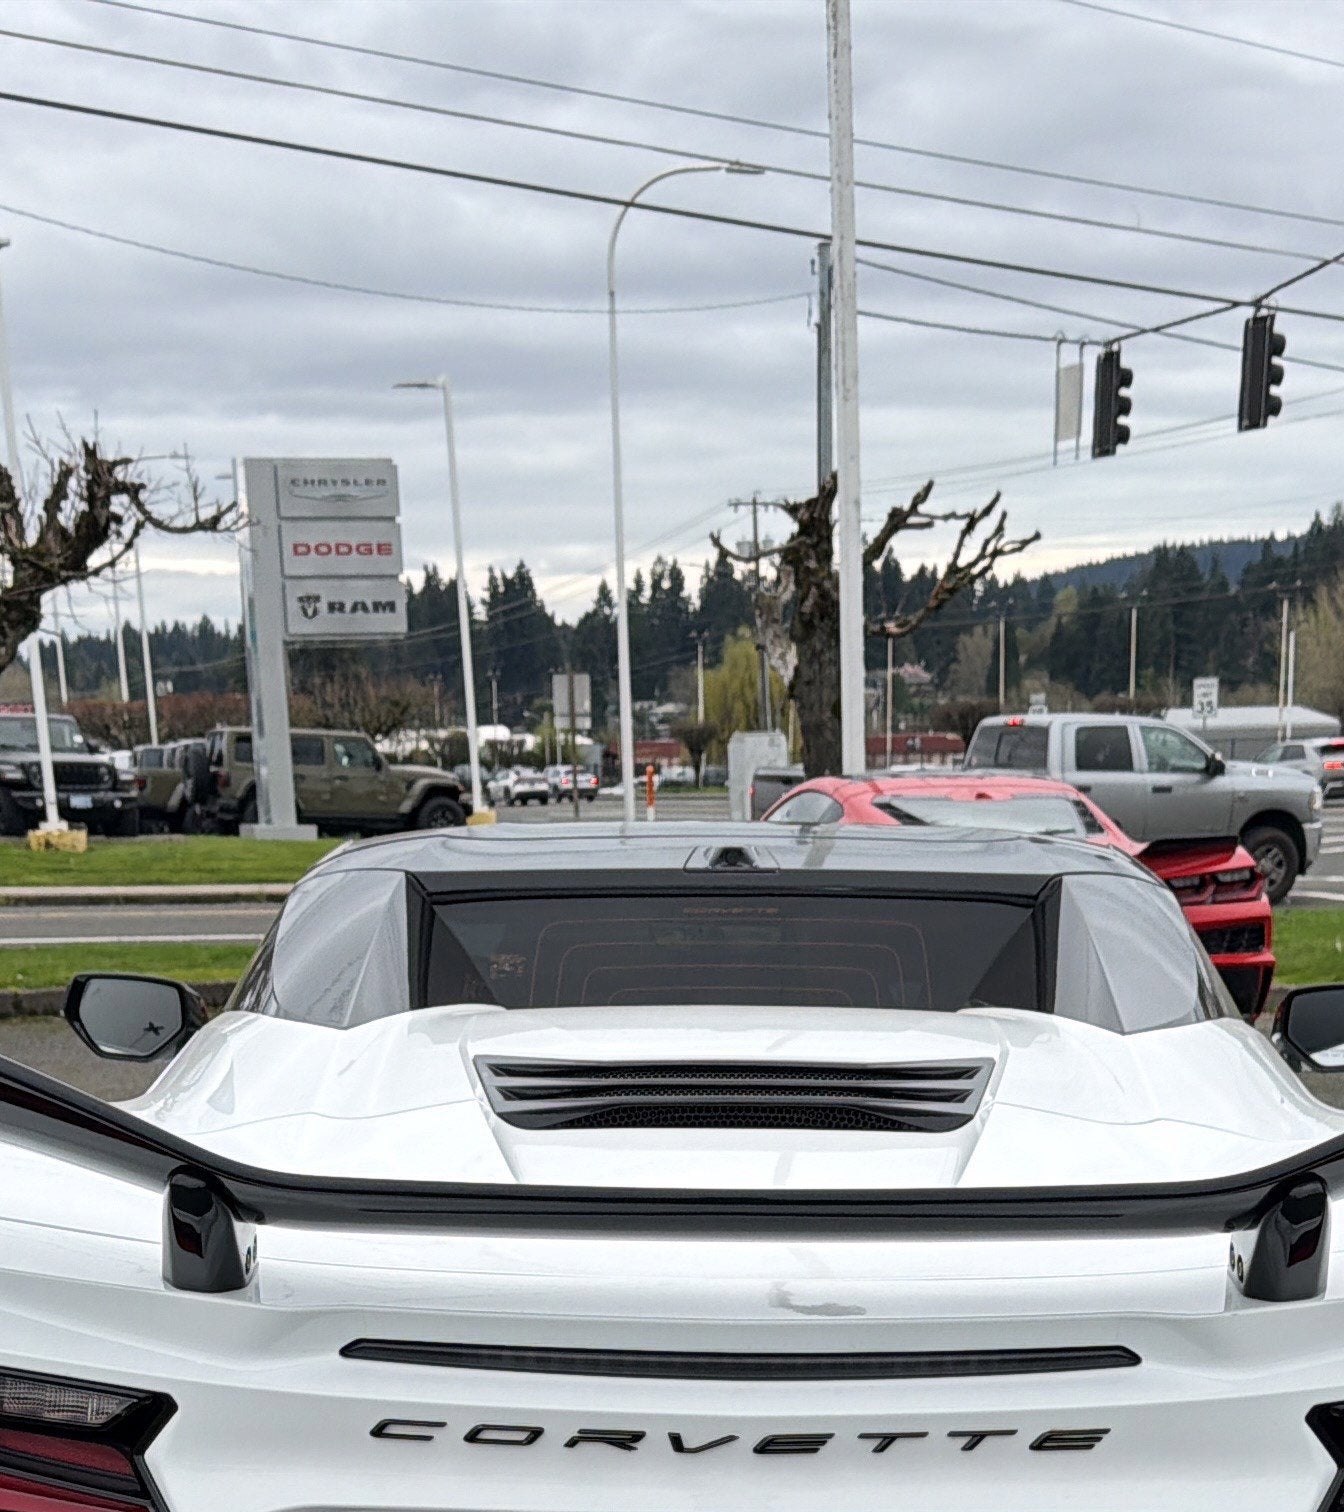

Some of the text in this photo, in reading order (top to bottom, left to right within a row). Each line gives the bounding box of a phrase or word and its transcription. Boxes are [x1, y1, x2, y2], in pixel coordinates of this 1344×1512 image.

[289, 477, 387, 488] CHRYSLER
[292, 542, 393, 556] DODGE
[326, 600, 396, 614] RAM
[369, 1418, 1112, 1455] CORVETTE
